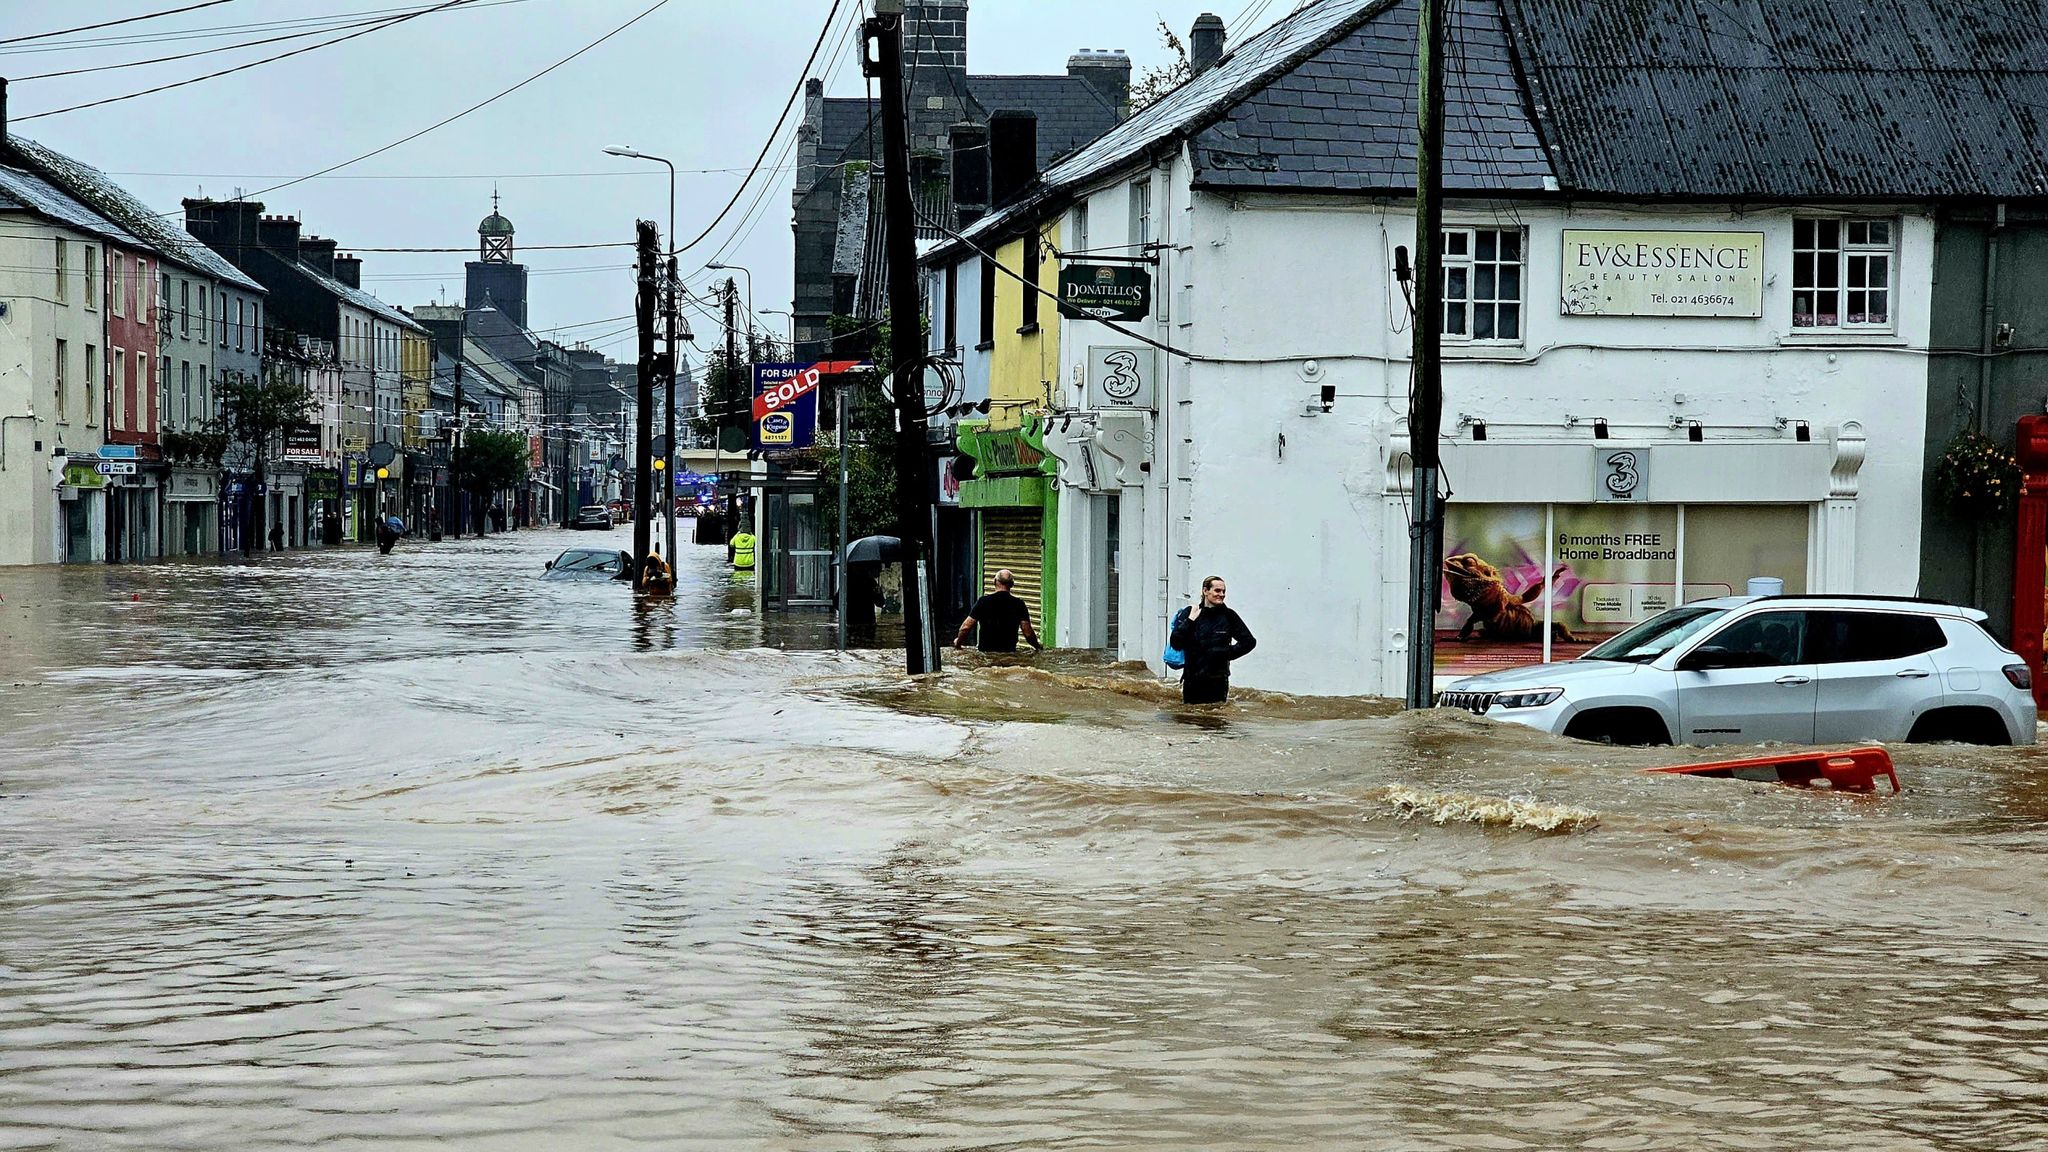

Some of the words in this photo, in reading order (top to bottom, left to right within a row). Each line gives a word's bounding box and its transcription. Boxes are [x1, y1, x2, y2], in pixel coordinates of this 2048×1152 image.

[1590, 273, 1660, 281] BEAUTY
[1677, 274, 1736, 282] SALON
[1651, 293, 1668, 304] Tel.
[1671, 296, 1688, 304] 021
[1691, 293, 1735, 306] 4636674
[1090, 309, 1111, 317] 50m
[761, 369, 780, 378] FOR
[1103, 351, 1140, 398] 3
[764, 368, 820, 409] SOLD
[1606, 451, 1639, 494] 3
[1559, 534, 1568, 545] 6
[1571, 534, 1621, 545] months
[1624, 534, 1661, 546] FREE
[1560, 547, 1599, 560] Home
[1603, 548, 1676, 560] Broadband
